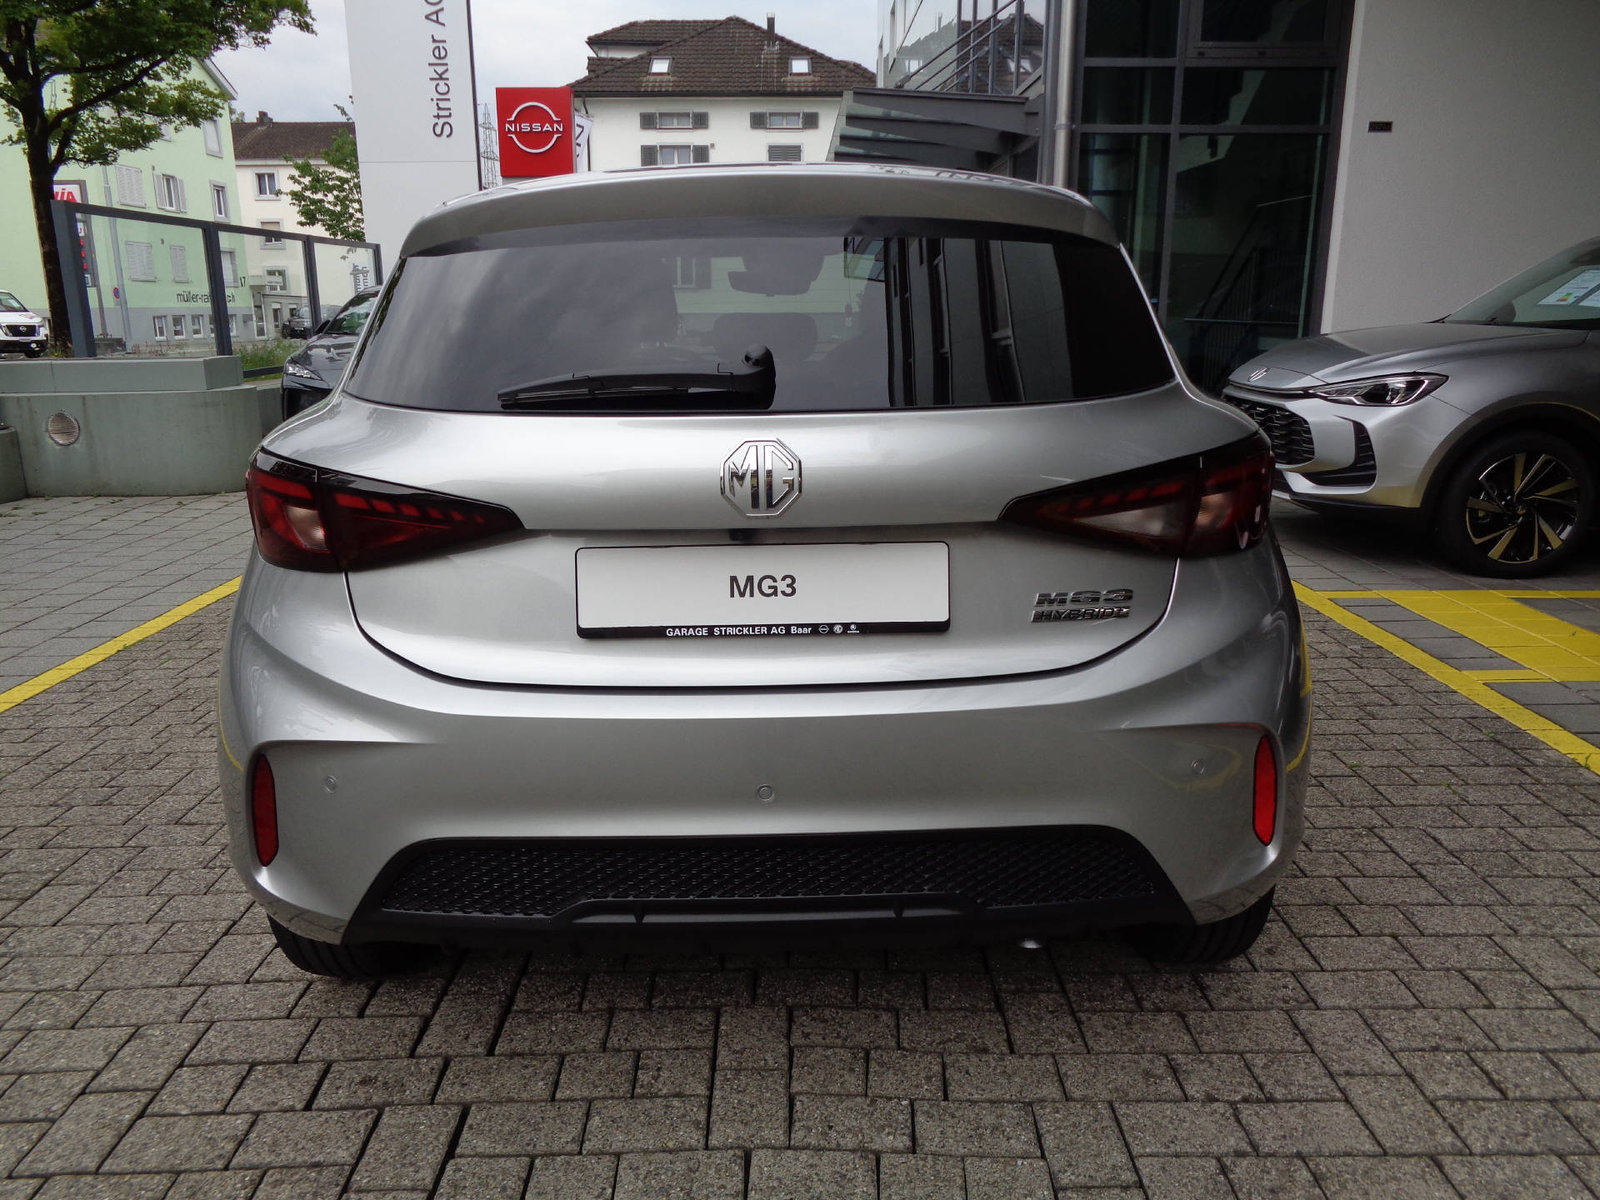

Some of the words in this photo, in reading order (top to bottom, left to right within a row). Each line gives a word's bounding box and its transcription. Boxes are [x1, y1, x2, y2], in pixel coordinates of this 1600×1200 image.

[427, 34, 453, 138] Strickler
[505, 123, 564, 132] NISSAN
[726, 443, 797, 511] MG
[729, 574, 797, 598] MG3
[666, 627, 709, 637] GARAGE
[713, 626, 768, 636] STRICKLER
[770, 626, 786, 634] AG
[791, 625, 812, 634] Baar
